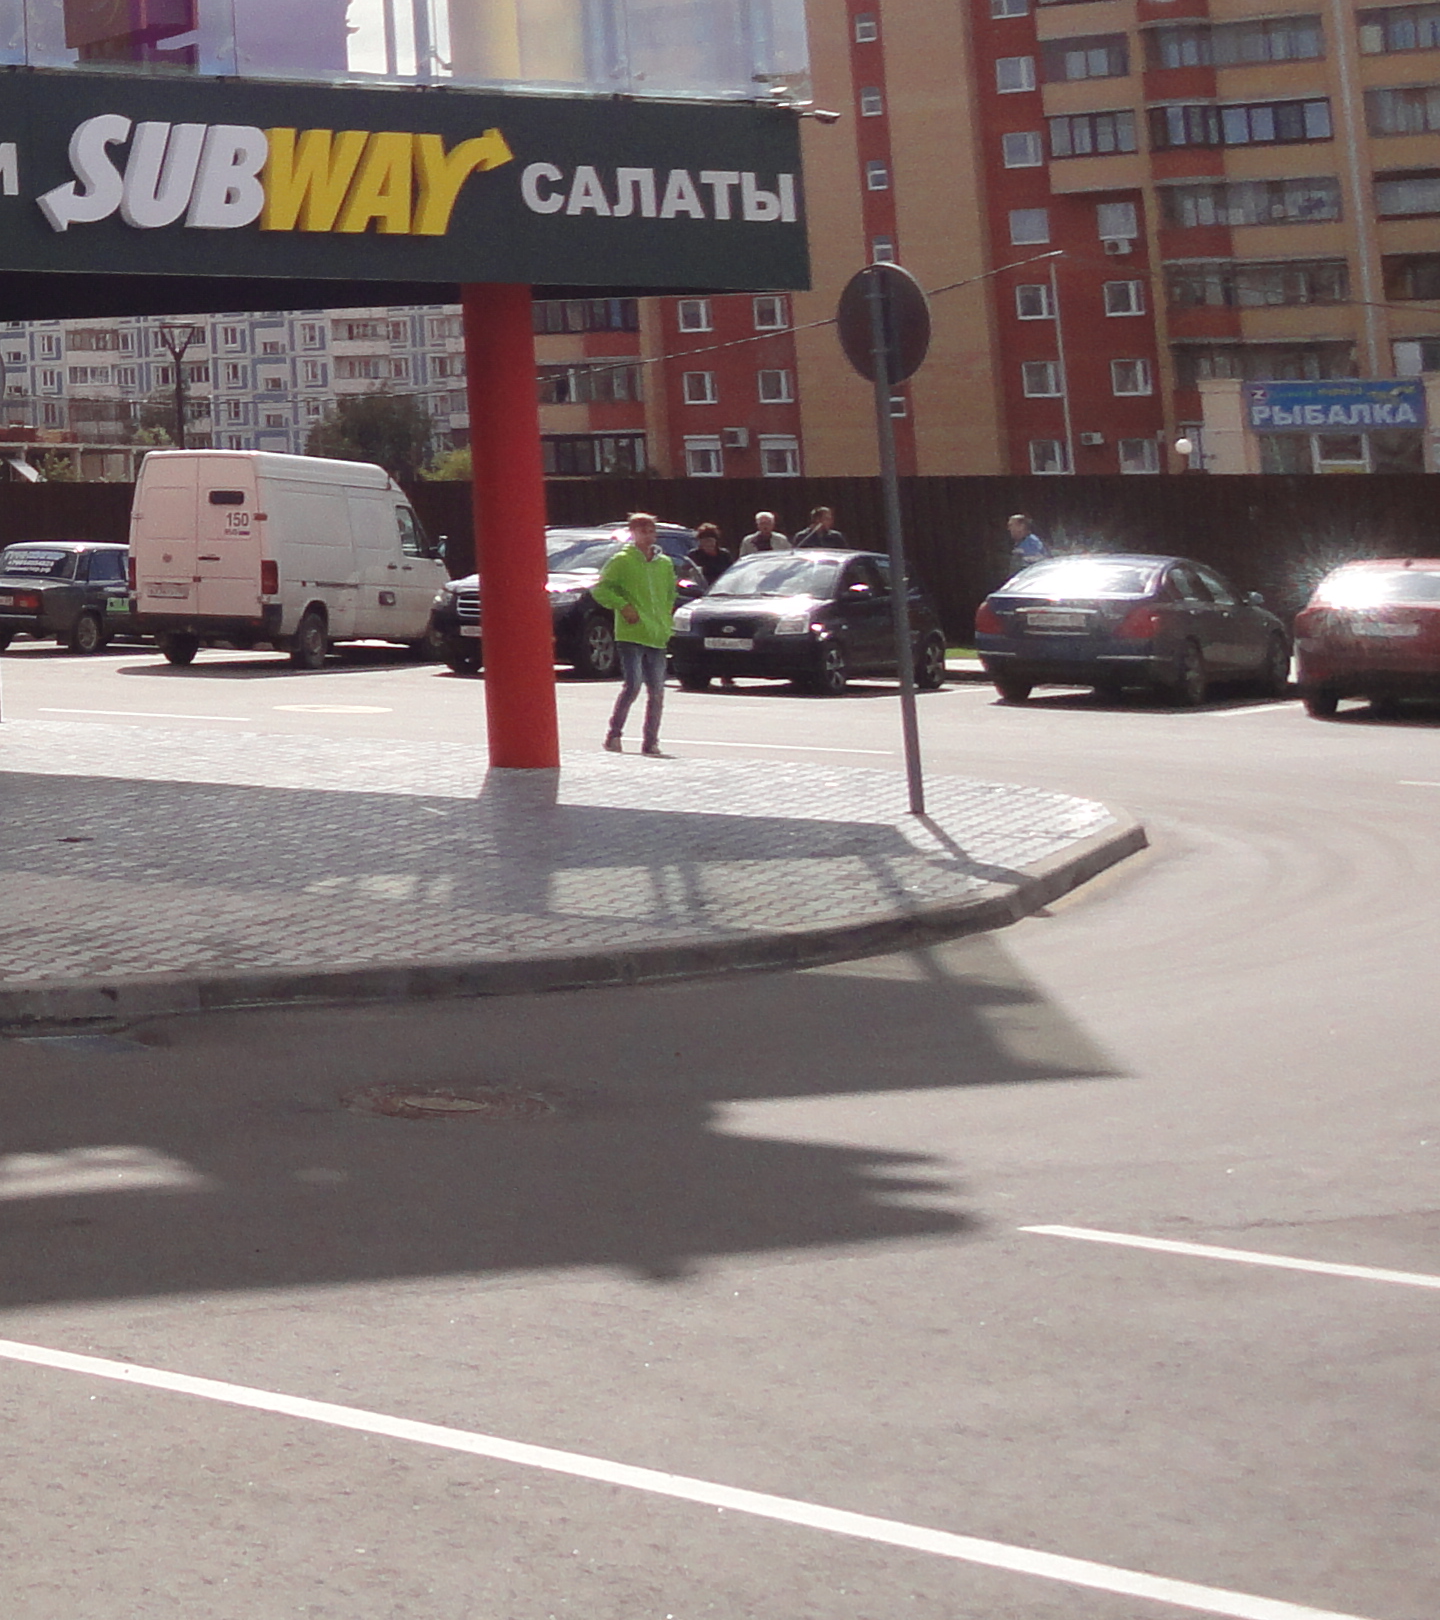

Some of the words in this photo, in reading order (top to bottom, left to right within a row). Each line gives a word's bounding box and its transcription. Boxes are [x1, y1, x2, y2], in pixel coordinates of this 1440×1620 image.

[36, 112, 514, 237] SUBWAY
[520, 162, 798, 224] САЛАТЫ
[1251, 403, 1417, 426] РЫБАЛКА
[226, 512, 249, 527] 150
